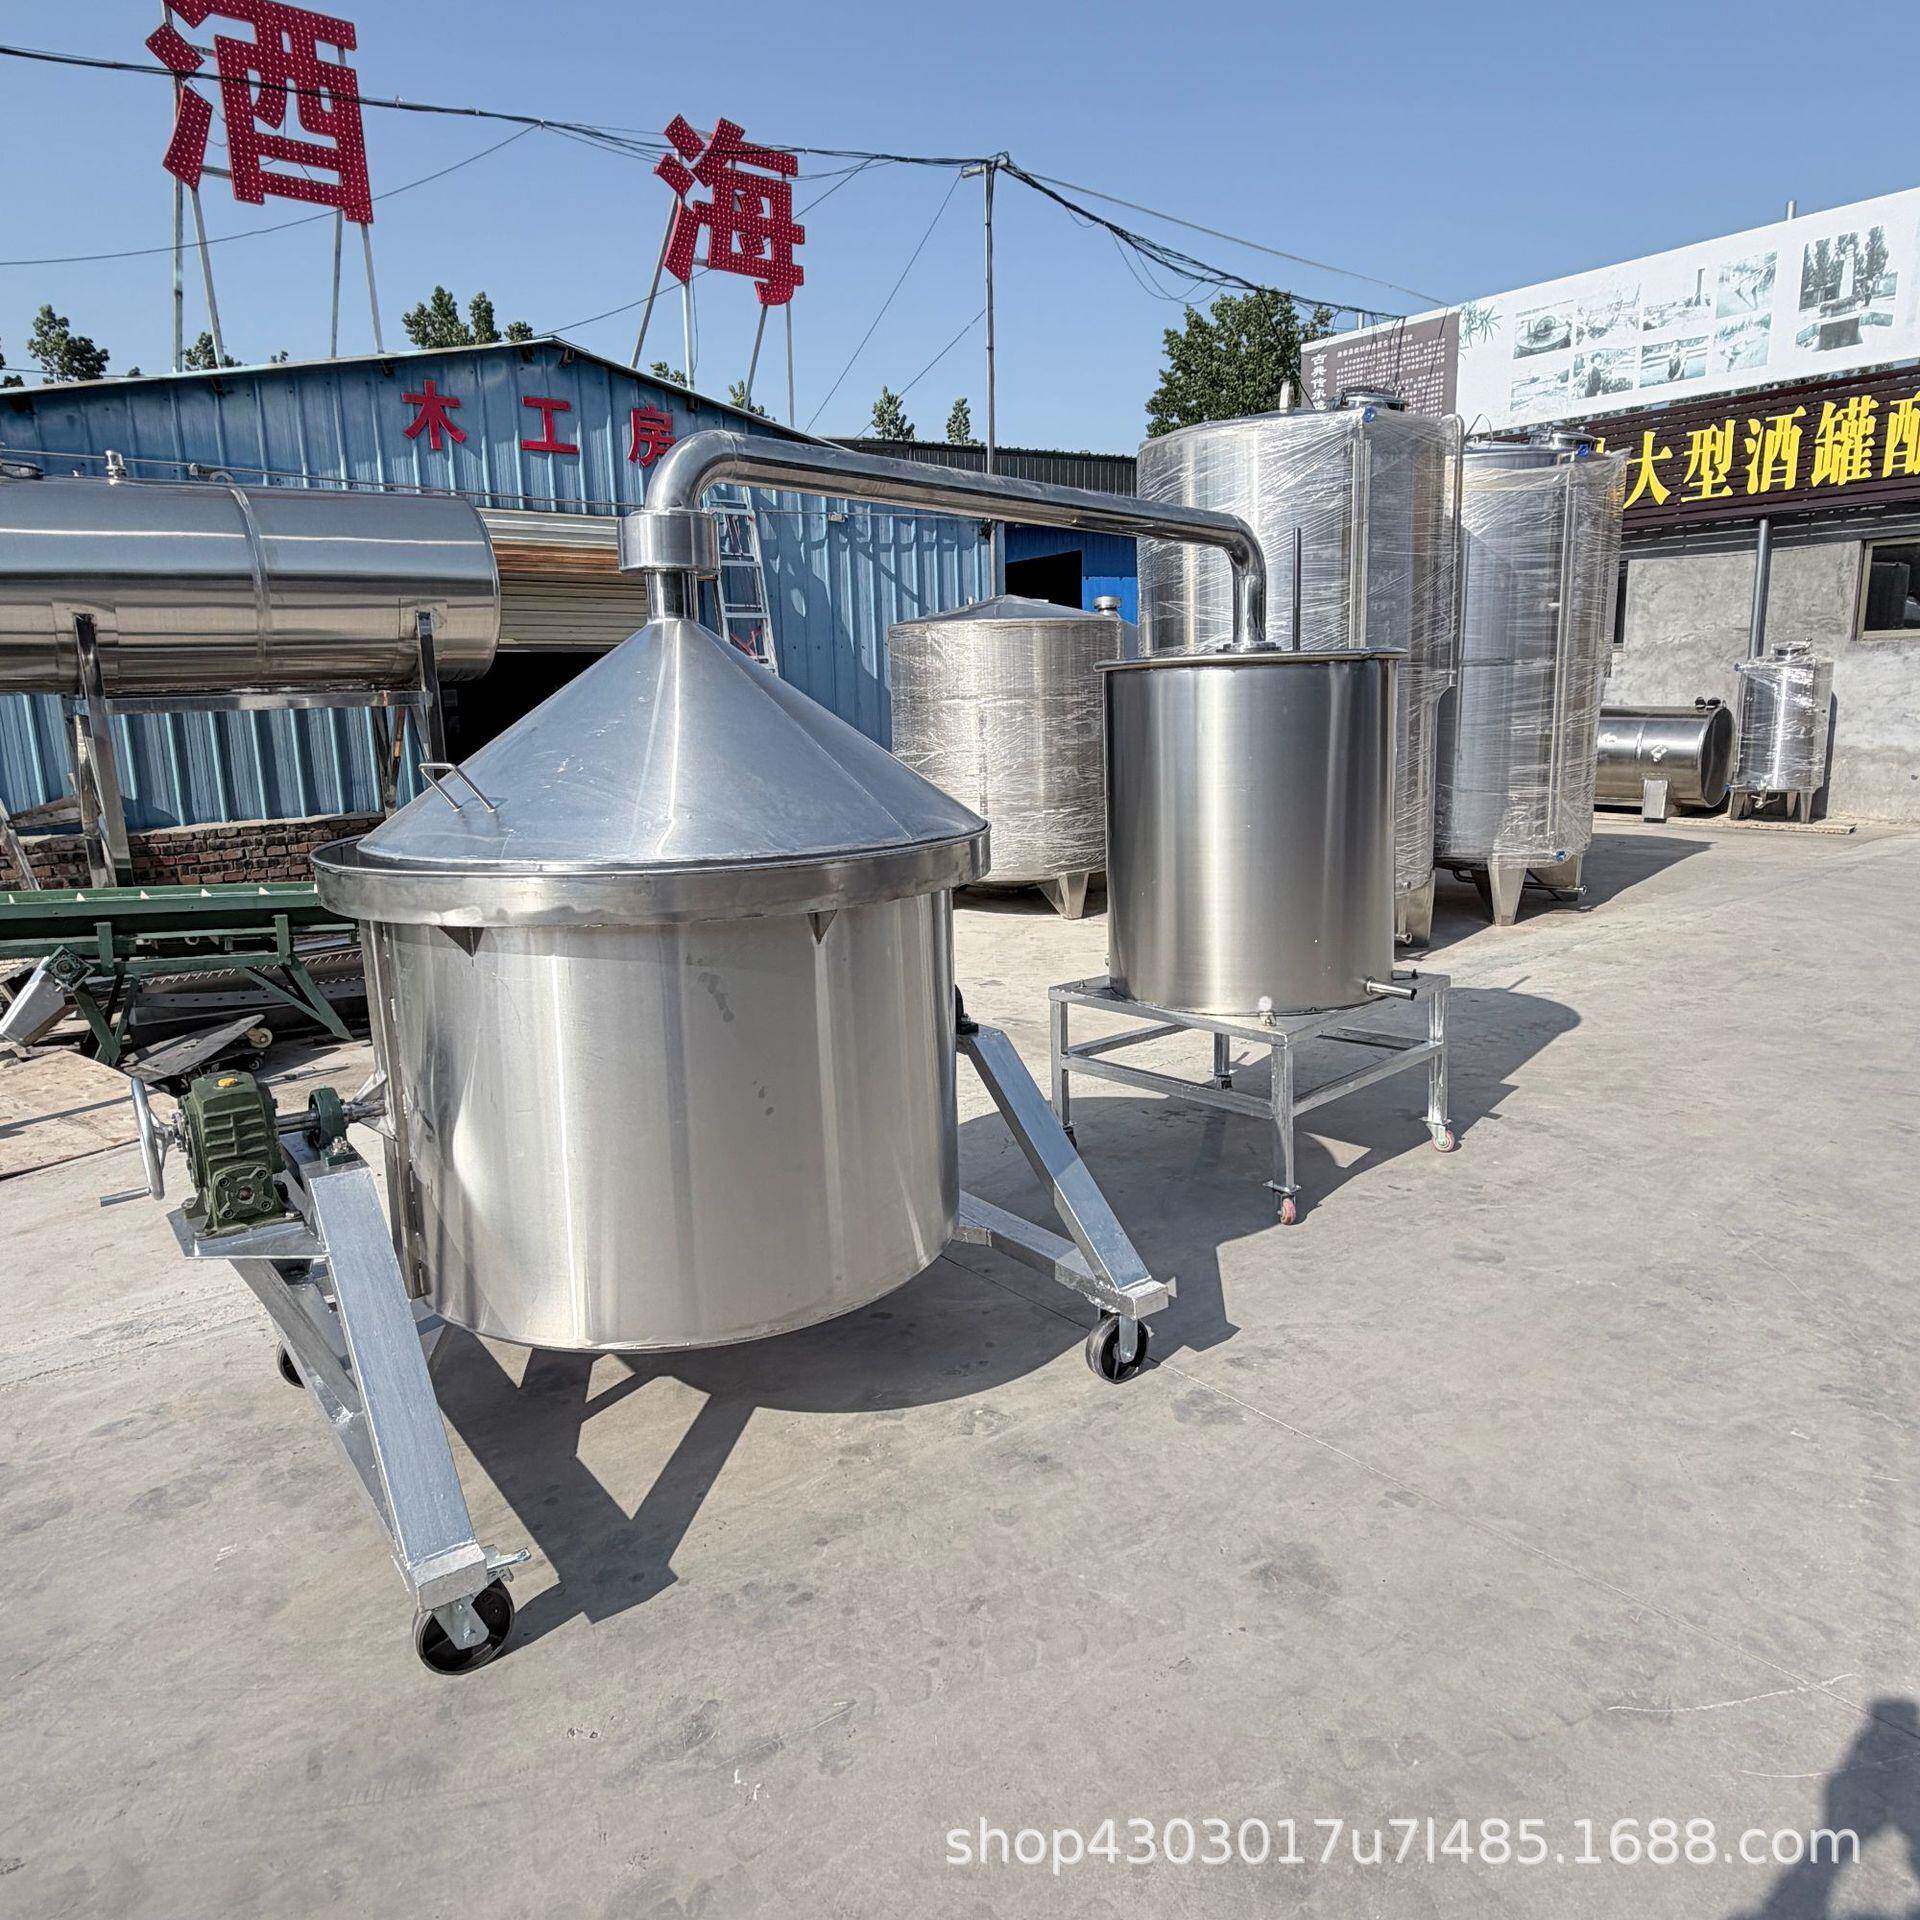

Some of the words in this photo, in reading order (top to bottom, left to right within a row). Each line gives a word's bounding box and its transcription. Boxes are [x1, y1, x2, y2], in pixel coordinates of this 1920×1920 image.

[402, 379, 677, 467] 木工房
[1596, 391, 1920, 509] 大型酒罐
